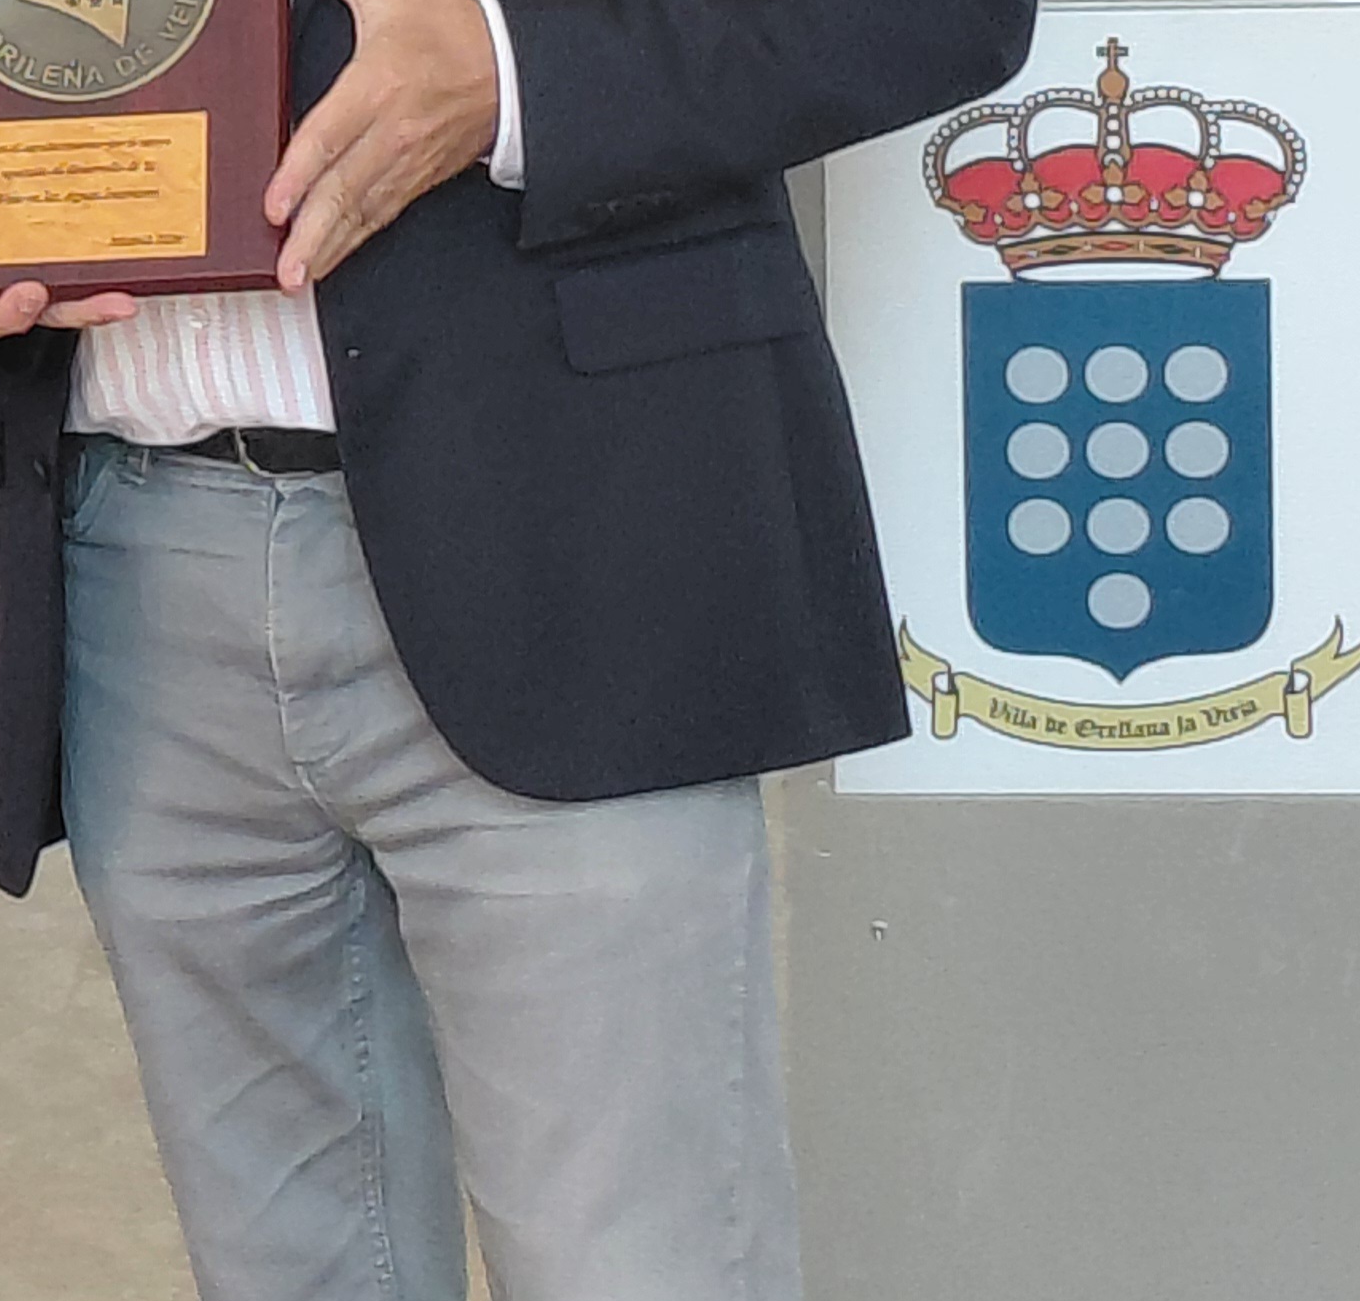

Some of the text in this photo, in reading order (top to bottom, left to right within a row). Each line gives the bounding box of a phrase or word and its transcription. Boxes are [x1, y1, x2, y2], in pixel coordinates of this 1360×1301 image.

[988, 697, 1037, 730] Villa
[1044, 713, 1069, 735] de
[1176, 715, 1198, 737] la
